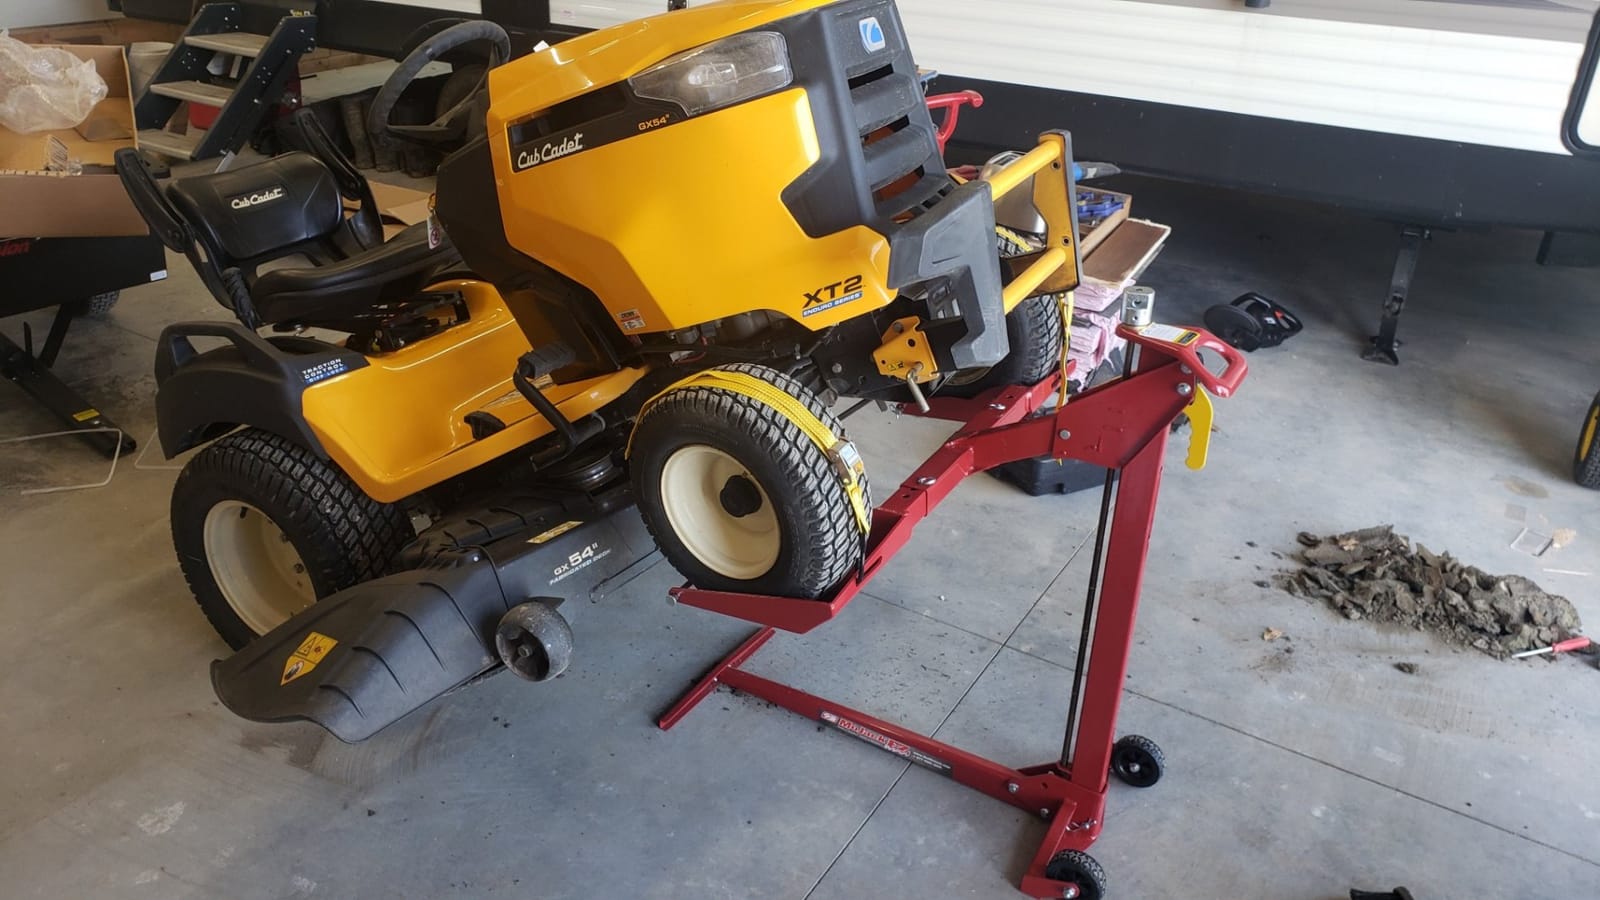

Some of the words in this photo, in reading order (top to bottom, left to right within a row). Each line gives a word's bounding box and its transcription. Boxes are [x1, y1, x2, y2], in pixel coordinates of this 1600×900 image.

[638, 114, 670, 131] GX54"
[517, 149, 541, 169] Cub
[541, 133, 584, 161] Cadet
[231, 197, 250, 209] Cub
[250, 188, 283, 205] Cadet
[802, 274, 863, 309] XT2
[803, 302, 833, 317] ENDURO
[834, 293, 861, 306] SERIES
[302, 358, 342, 375] TRACTION
[304, 363, 344, 380] CONTROL
[554, 563, 569, 576] GX
[568, 542, 599, 567] 54"
[549, 559, 592, 585] FABRICATED
